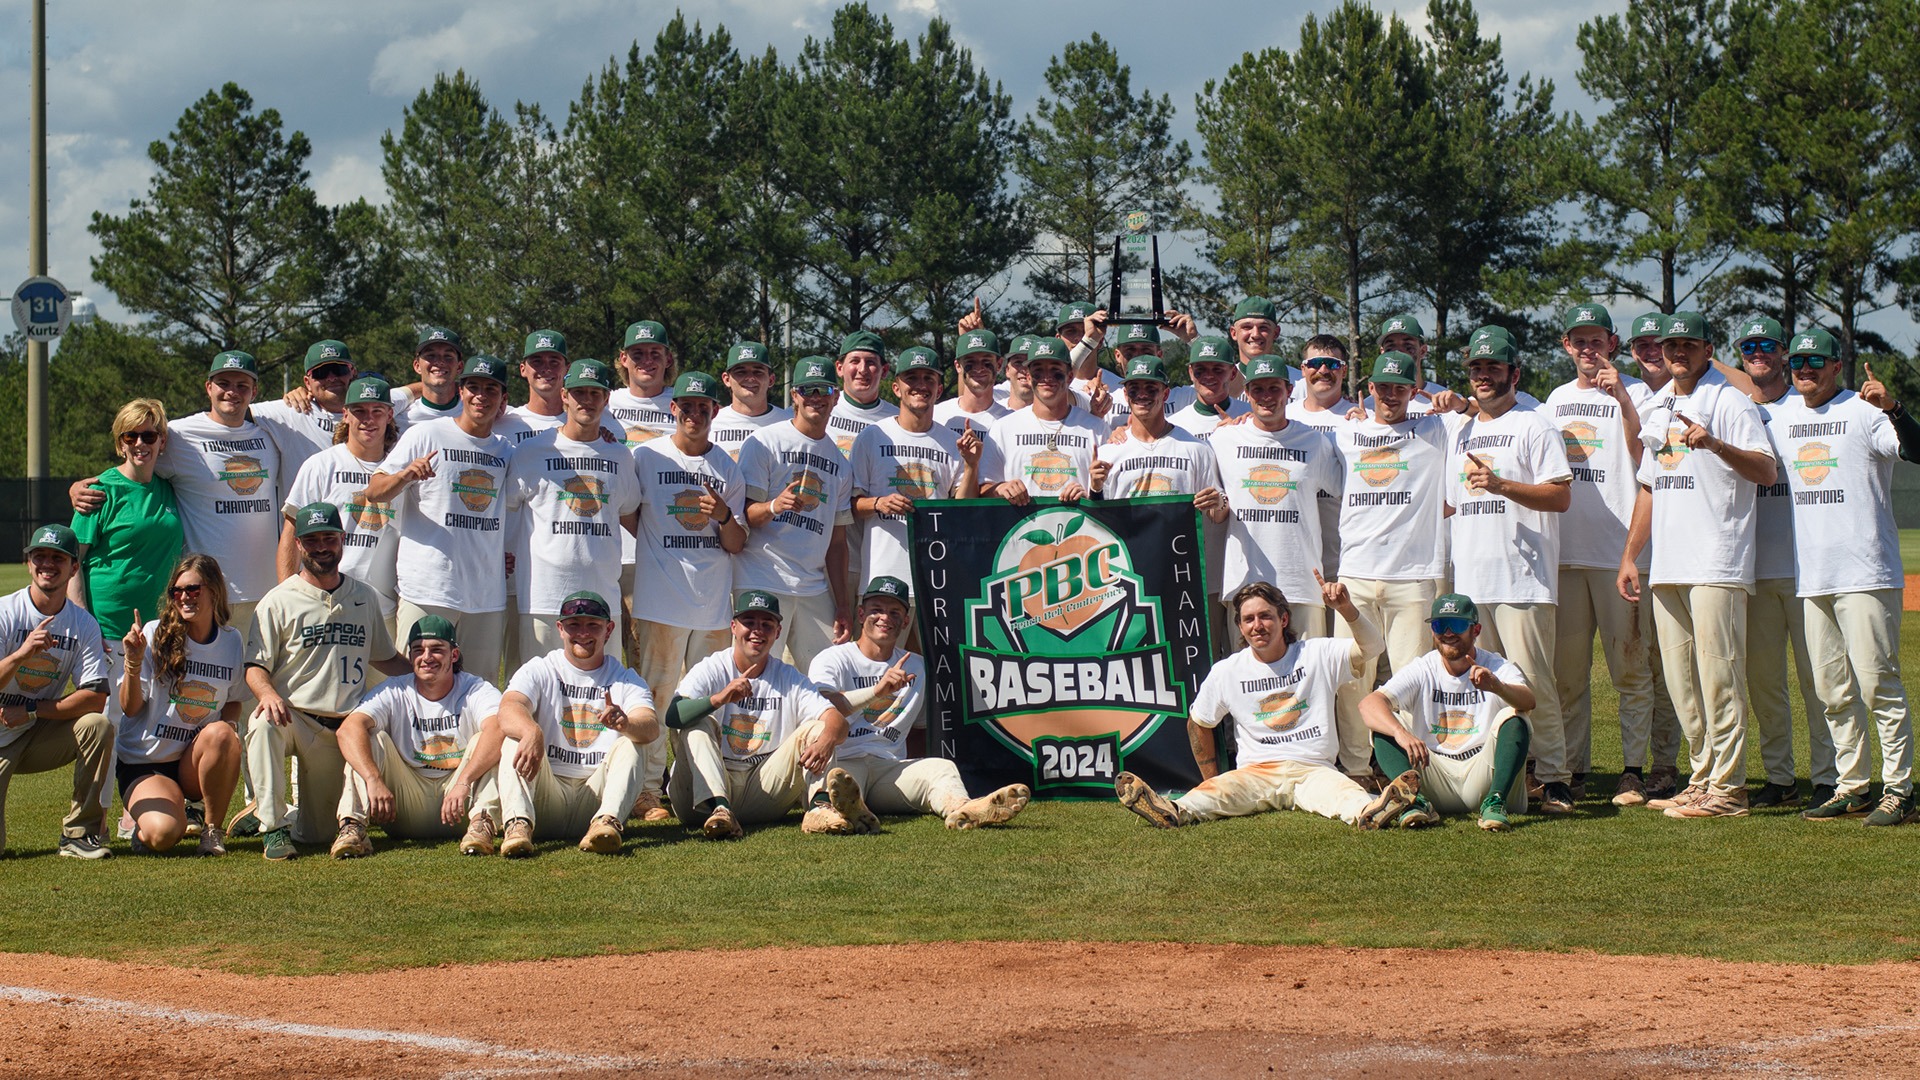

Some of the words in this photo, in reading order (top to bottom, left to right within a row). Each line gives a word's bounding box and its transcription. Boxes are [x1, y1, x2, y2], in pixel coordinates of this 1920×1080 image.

[1127, 234, 1146, 243] 2024
[33, 297, 54, 313] 31
[27, 325, 60, 336] Kurtz
[612, 408, 677, 424] TOURNAMEN
[1555, 403, 1617, 419] TOURNAMENT
[1788, 421, 1849, 439] TOURNAMENT
[202, 438, 267, 453] TOURNAMENT
[879, 444, 950, 465] TOURNAMENT
[1236, 445, 1308, 463] TOURNAMENT
[443, 448, 506, 469] TOURNAMENT
[545, 457, 619, 475] TOURNAMENT
[780, 450, 839, 477] TOURNAMENT
[1120, 456, 1190, 472] TOURNAMENT
[335, 471, 370, 485] TOURN
[1570, 467, 1605, 483] PIONS
[215, 499, 271, 515] CHAMPIONS
[1348, 491, 1412, 507] CHAMPIONS
[444, 512, 500, 532] CHAMPIONS
[1236, 508, 1300, 524] CHAMPIONS
[663, 535, 721, 549] CHAMPIONS
[1005, 541, 1122, 619] PBC
[1010, 615, 1042, 632] Peach
[1044, 606, 1064, 621] Belt
[1066, 586, 1125, 613] Conference
[1171, 534, 1200, 694] CHAMPI
[301, 622, 366, 639] GEORGIA
[928, 512, 956, 760] TOURNAMEN
[302, 633, 367, 650] COLLEGE
[185, 660, 234, 682] RNAMENT
[340, 654, 365, 685] 15
[969, 652, 1177, 713] BASEBALL
[1239, 666, 1307, 695] TOURNAMENT
[1042, 742, 1114, 780] 2024
